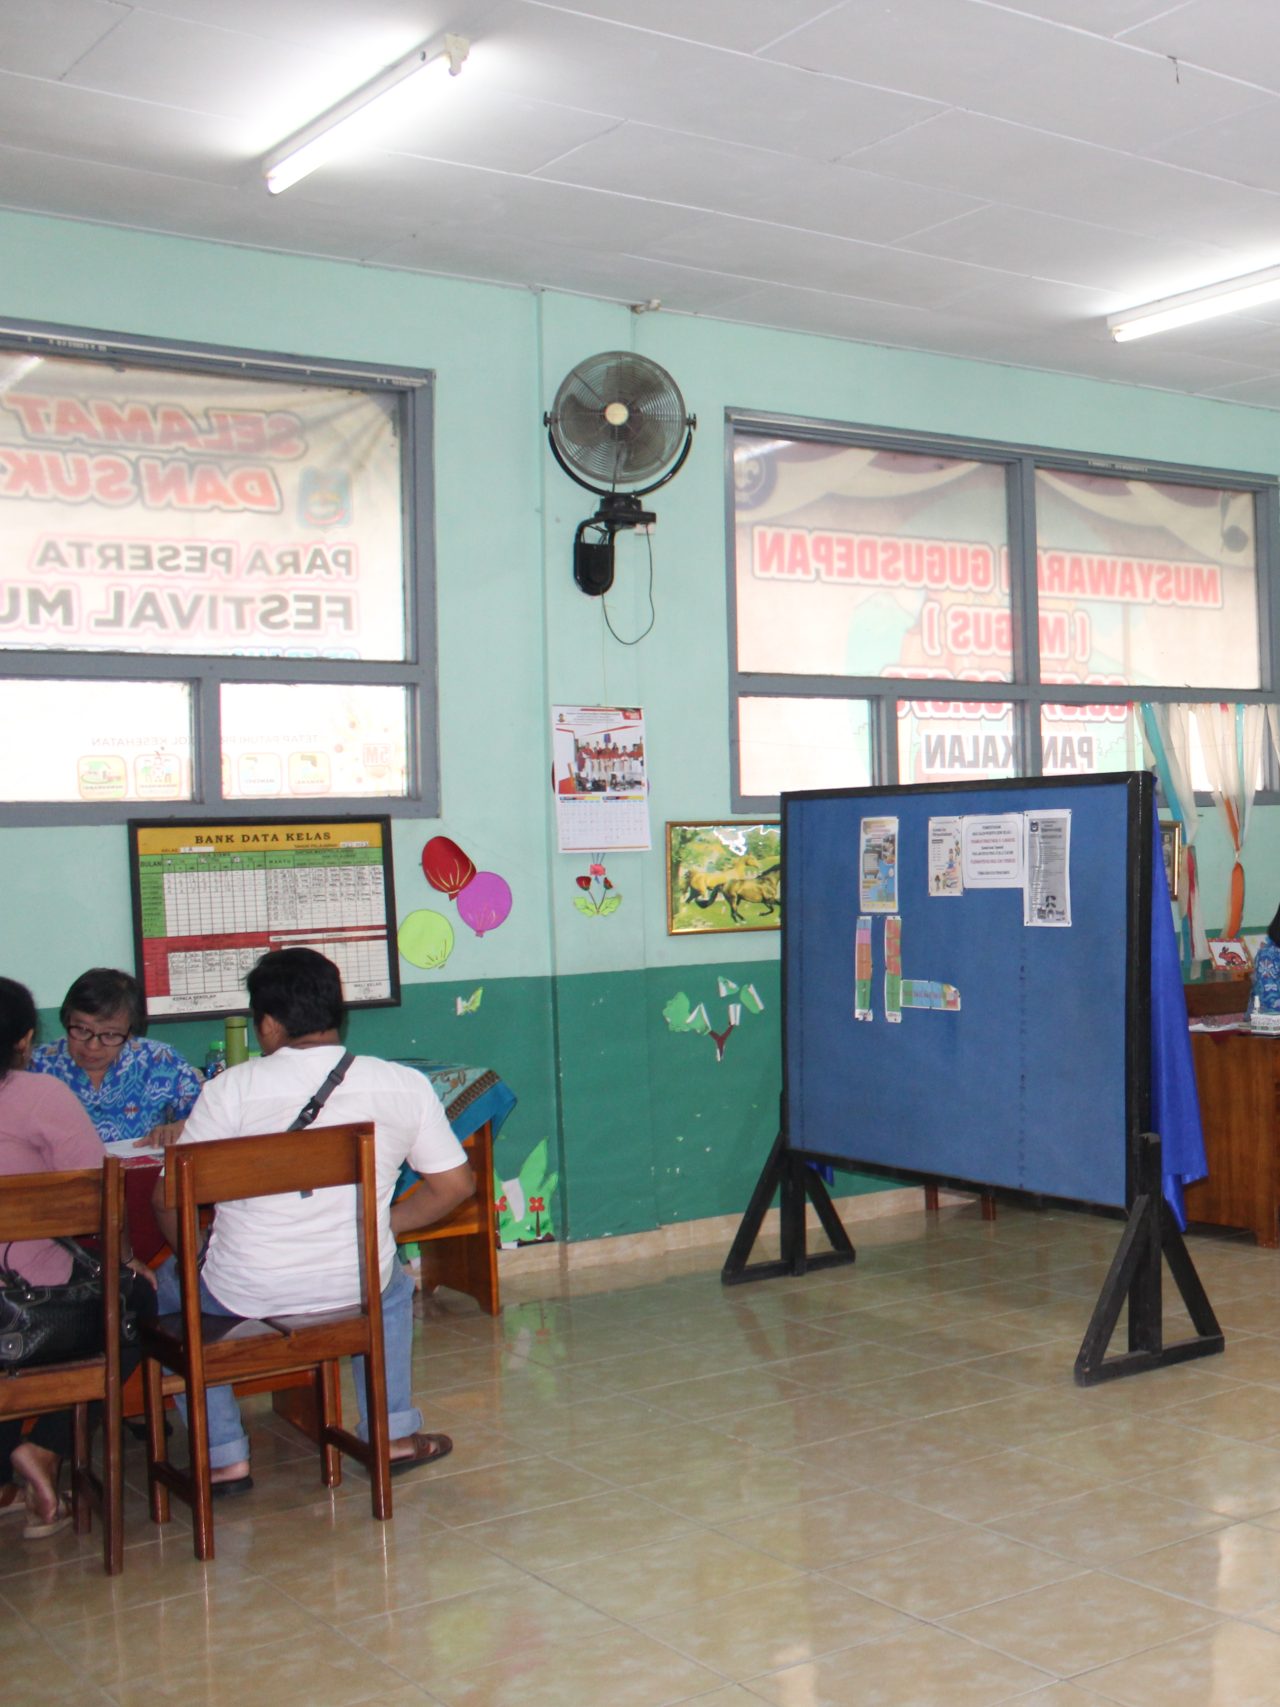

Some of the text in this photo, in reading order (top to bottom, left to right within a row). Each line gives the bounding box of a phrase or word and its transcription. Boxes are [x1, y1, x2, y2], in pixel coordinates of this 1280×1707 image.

[195, 831, 332, 844] BANK DATA KELAS
